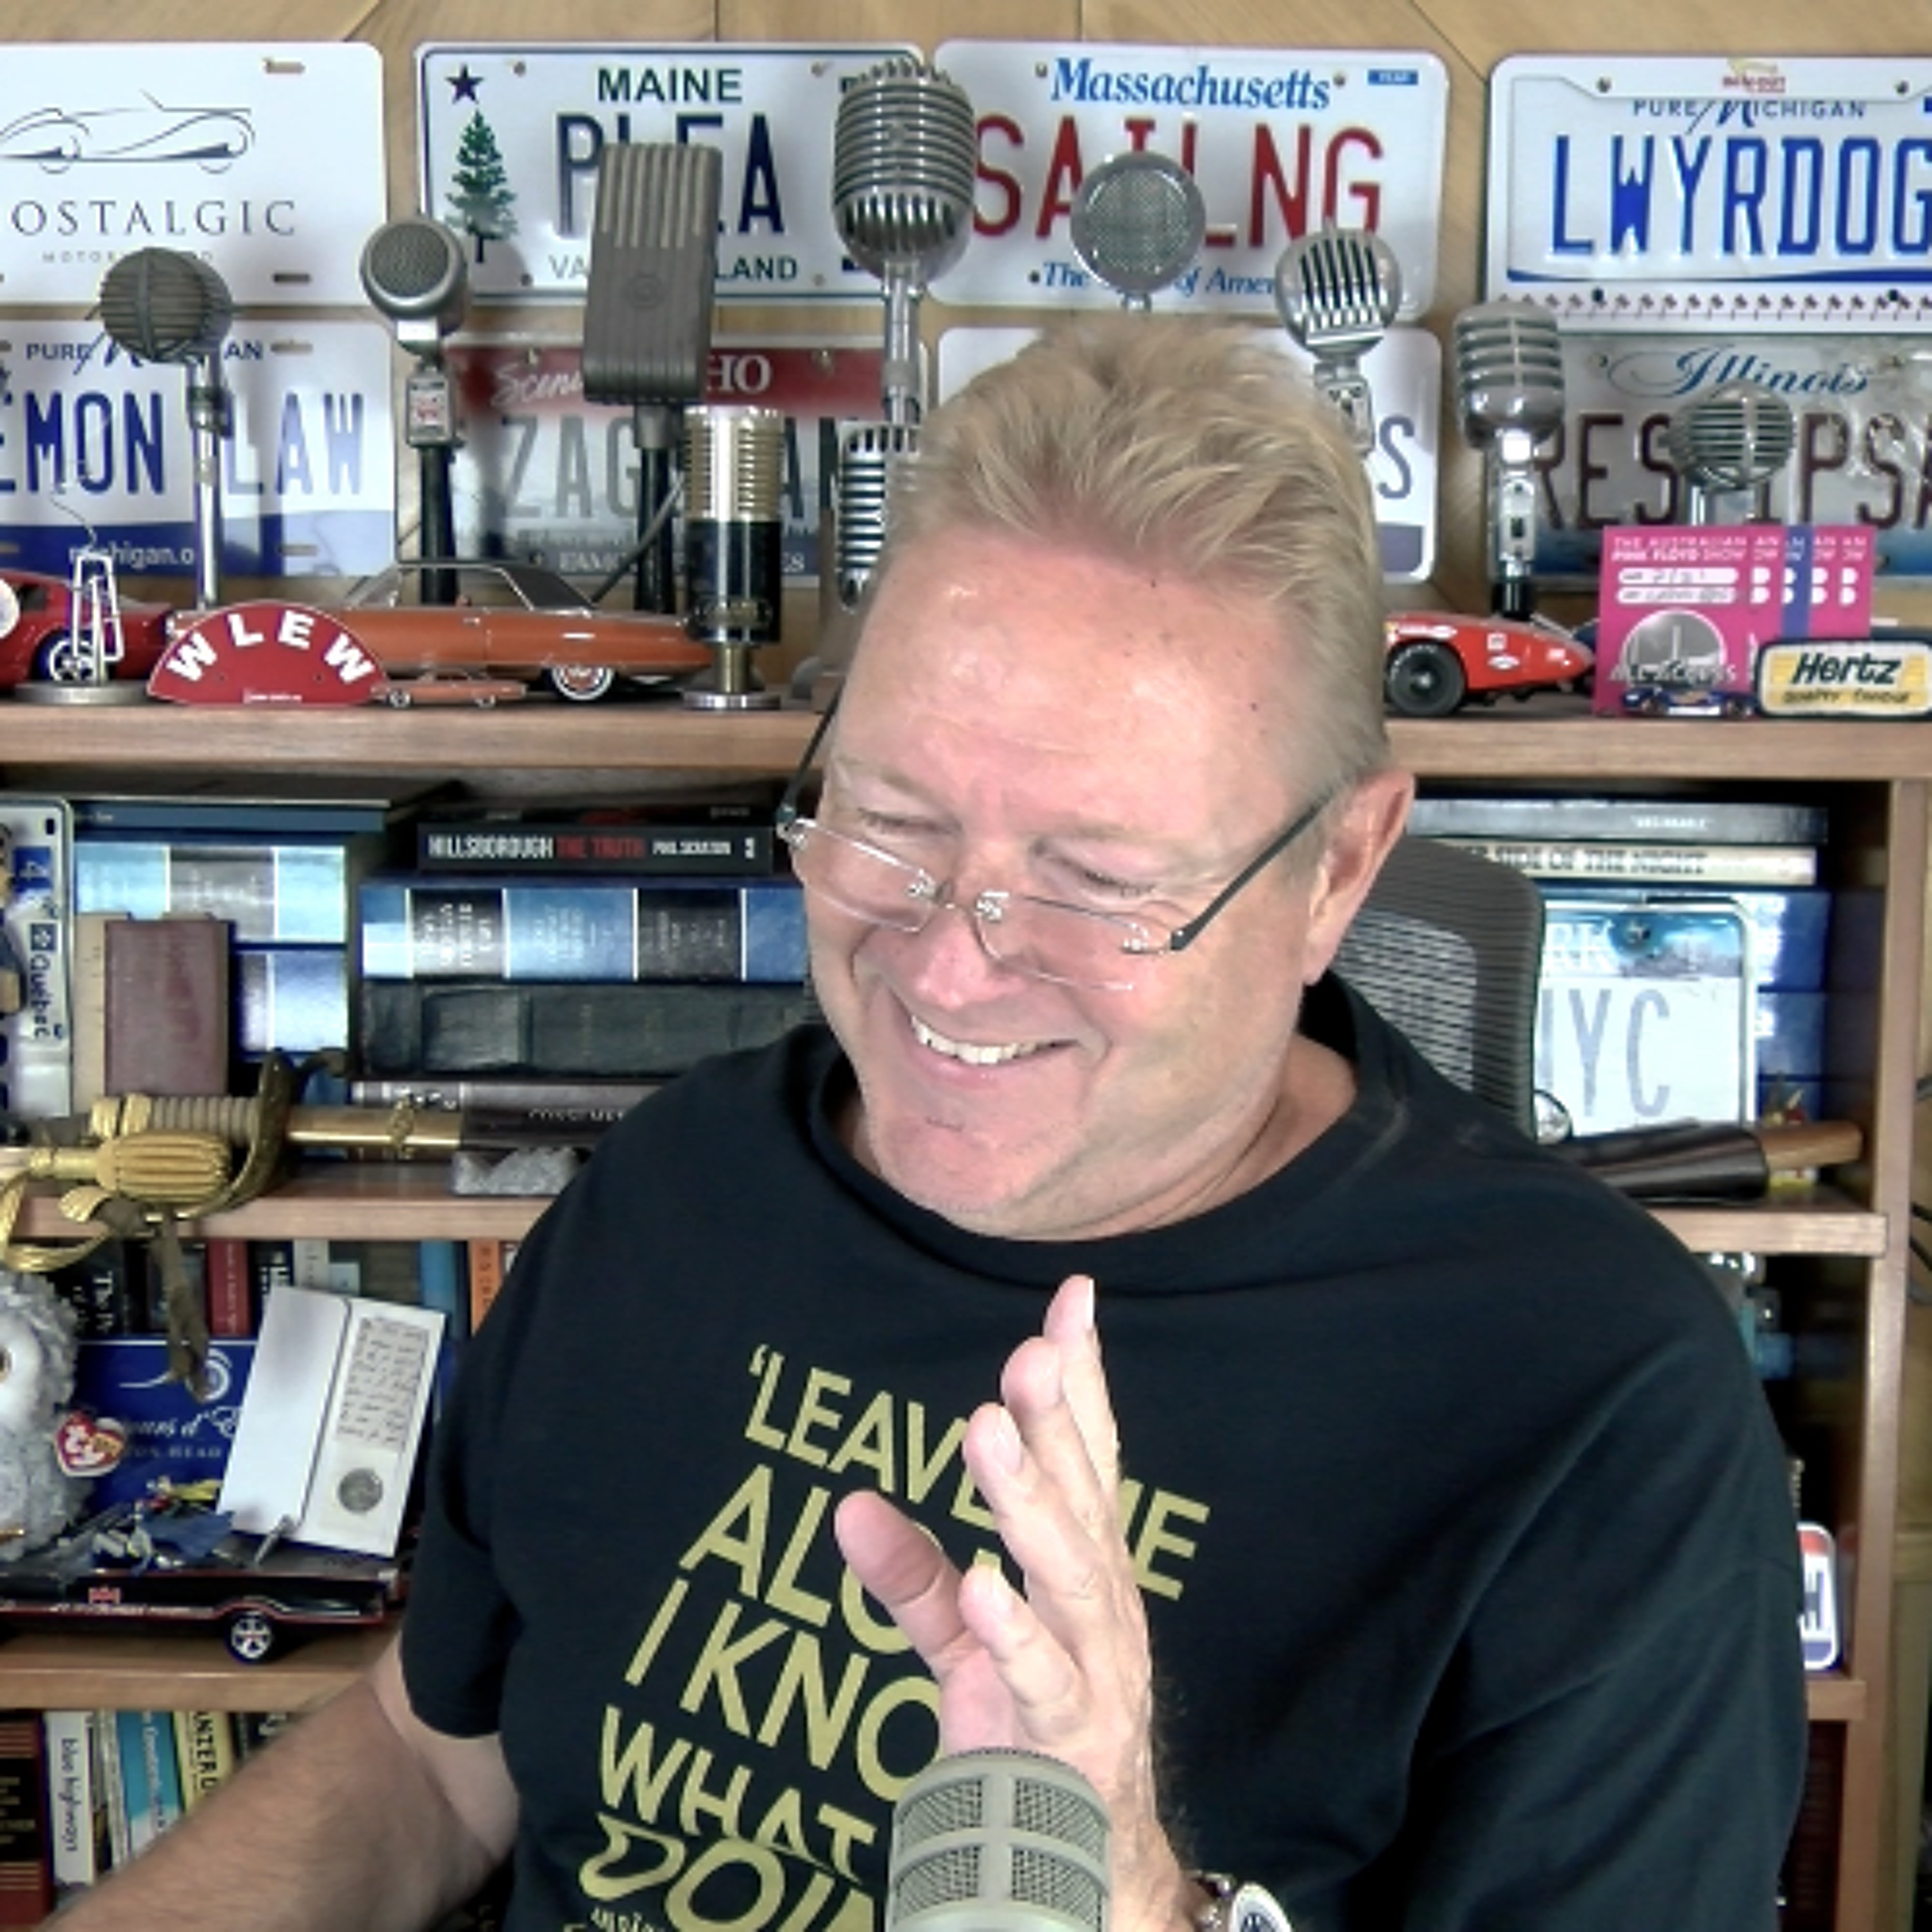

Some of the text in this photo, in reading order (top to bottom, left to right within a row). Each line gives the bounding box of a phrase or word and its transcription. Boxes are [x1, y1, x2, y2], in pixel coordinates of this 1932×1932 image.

[598, 68, 742, 102] MAINE
[1050, 58, 1331, 109] Massachusetts
[1633, 99, 1866, 128] PURE MICHIGAN
[11, 200, 295, 236] OSTALGIC
[1552, 134, 1932, 256] LWYRDOG
[1205, 266, 1275, 295] Amer
[26, 342, 91, 361] PURE
[1667, 343, 1871, 397] Illinois
[223, 392, 364, 495] LAW
[165, 609, 375, 685] WLEW
[1792, 652, 1902, 685] Hertz
[428, 835, 554, 859] HILLSBOROUGH
[556, 837, 587, 858] THE
[591, 837, 644, 858] TRUTH
[1539, 988, 1670, 1118] YC
[624, 1577, 940, 1803] I KNO
[57, 1737, 82, 1852] blue highways
[599, 1703, 877, 1886] WHAT
